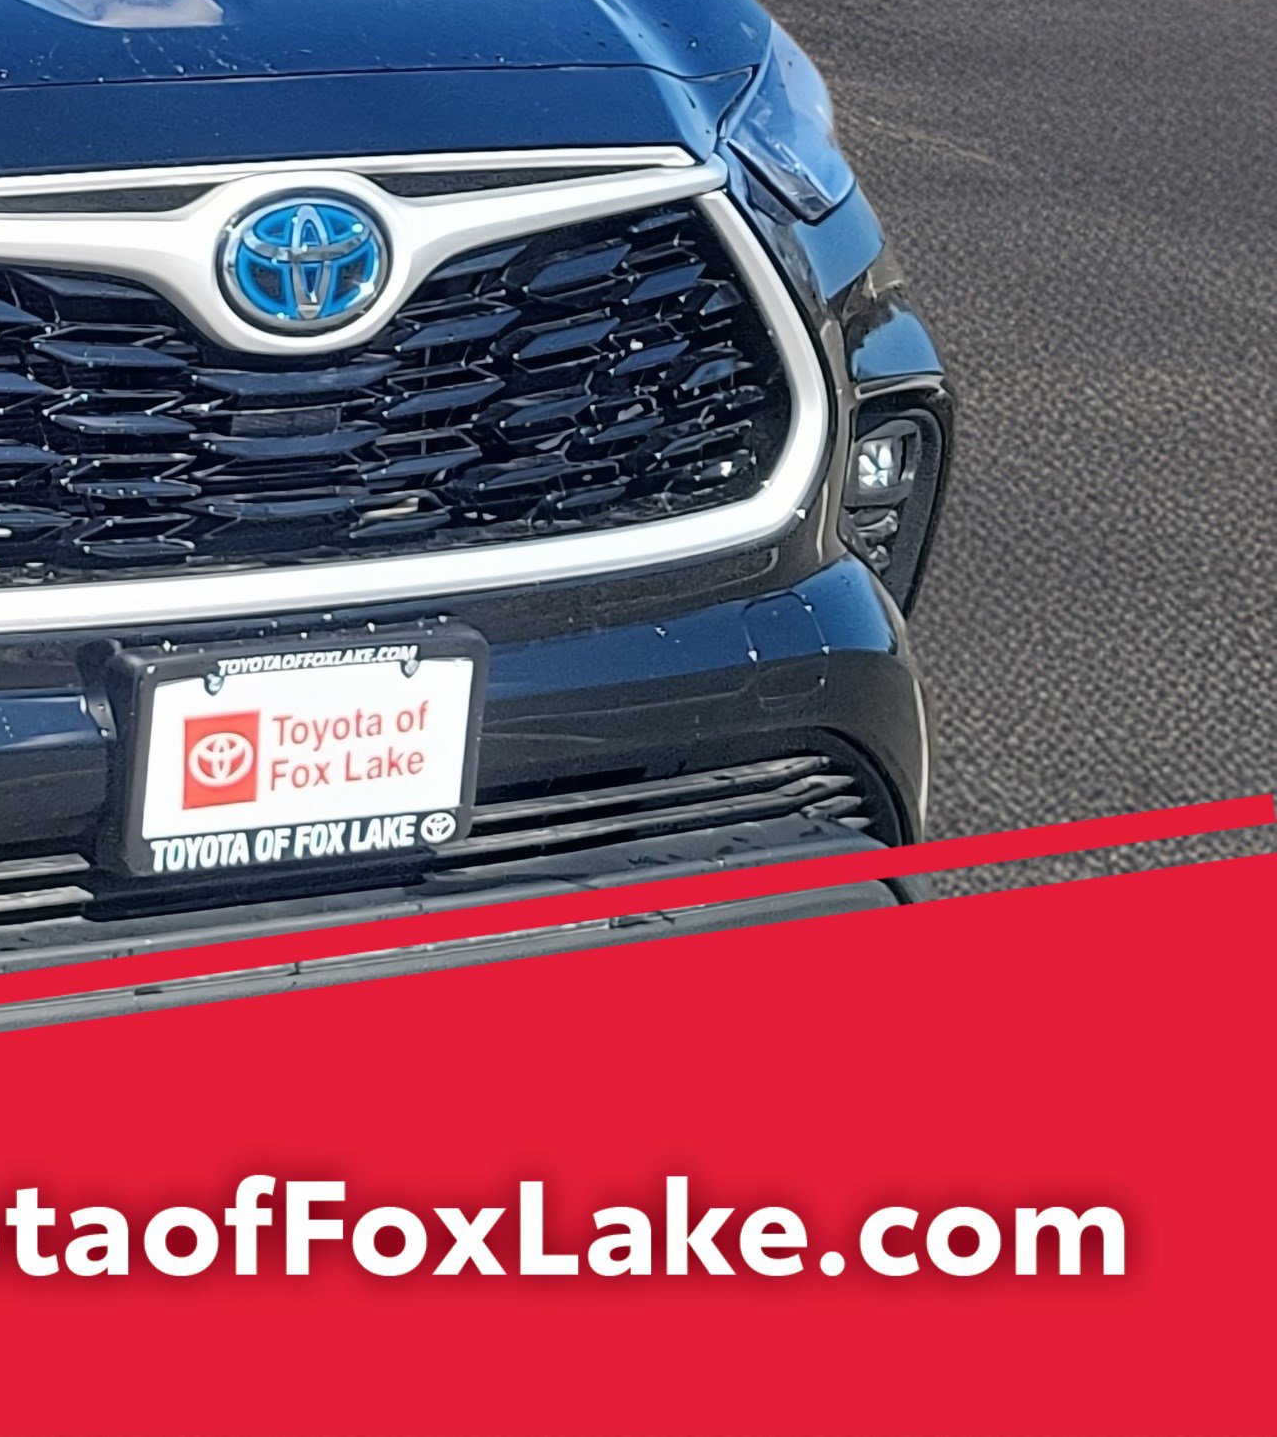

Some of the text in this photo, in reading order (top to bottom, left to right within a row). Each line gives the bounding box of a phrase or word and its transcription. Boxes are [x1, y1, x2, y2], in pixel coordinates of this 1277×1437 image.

[218, 645, 418, 676] TOYOTAOFFOXLAKE.COM
[272, 699, 430, 751] Toyota of
[270, 746, 425, 792] Fox Lake
[150, 814, 417, 873] TOYOTA OF FOX LAKE
